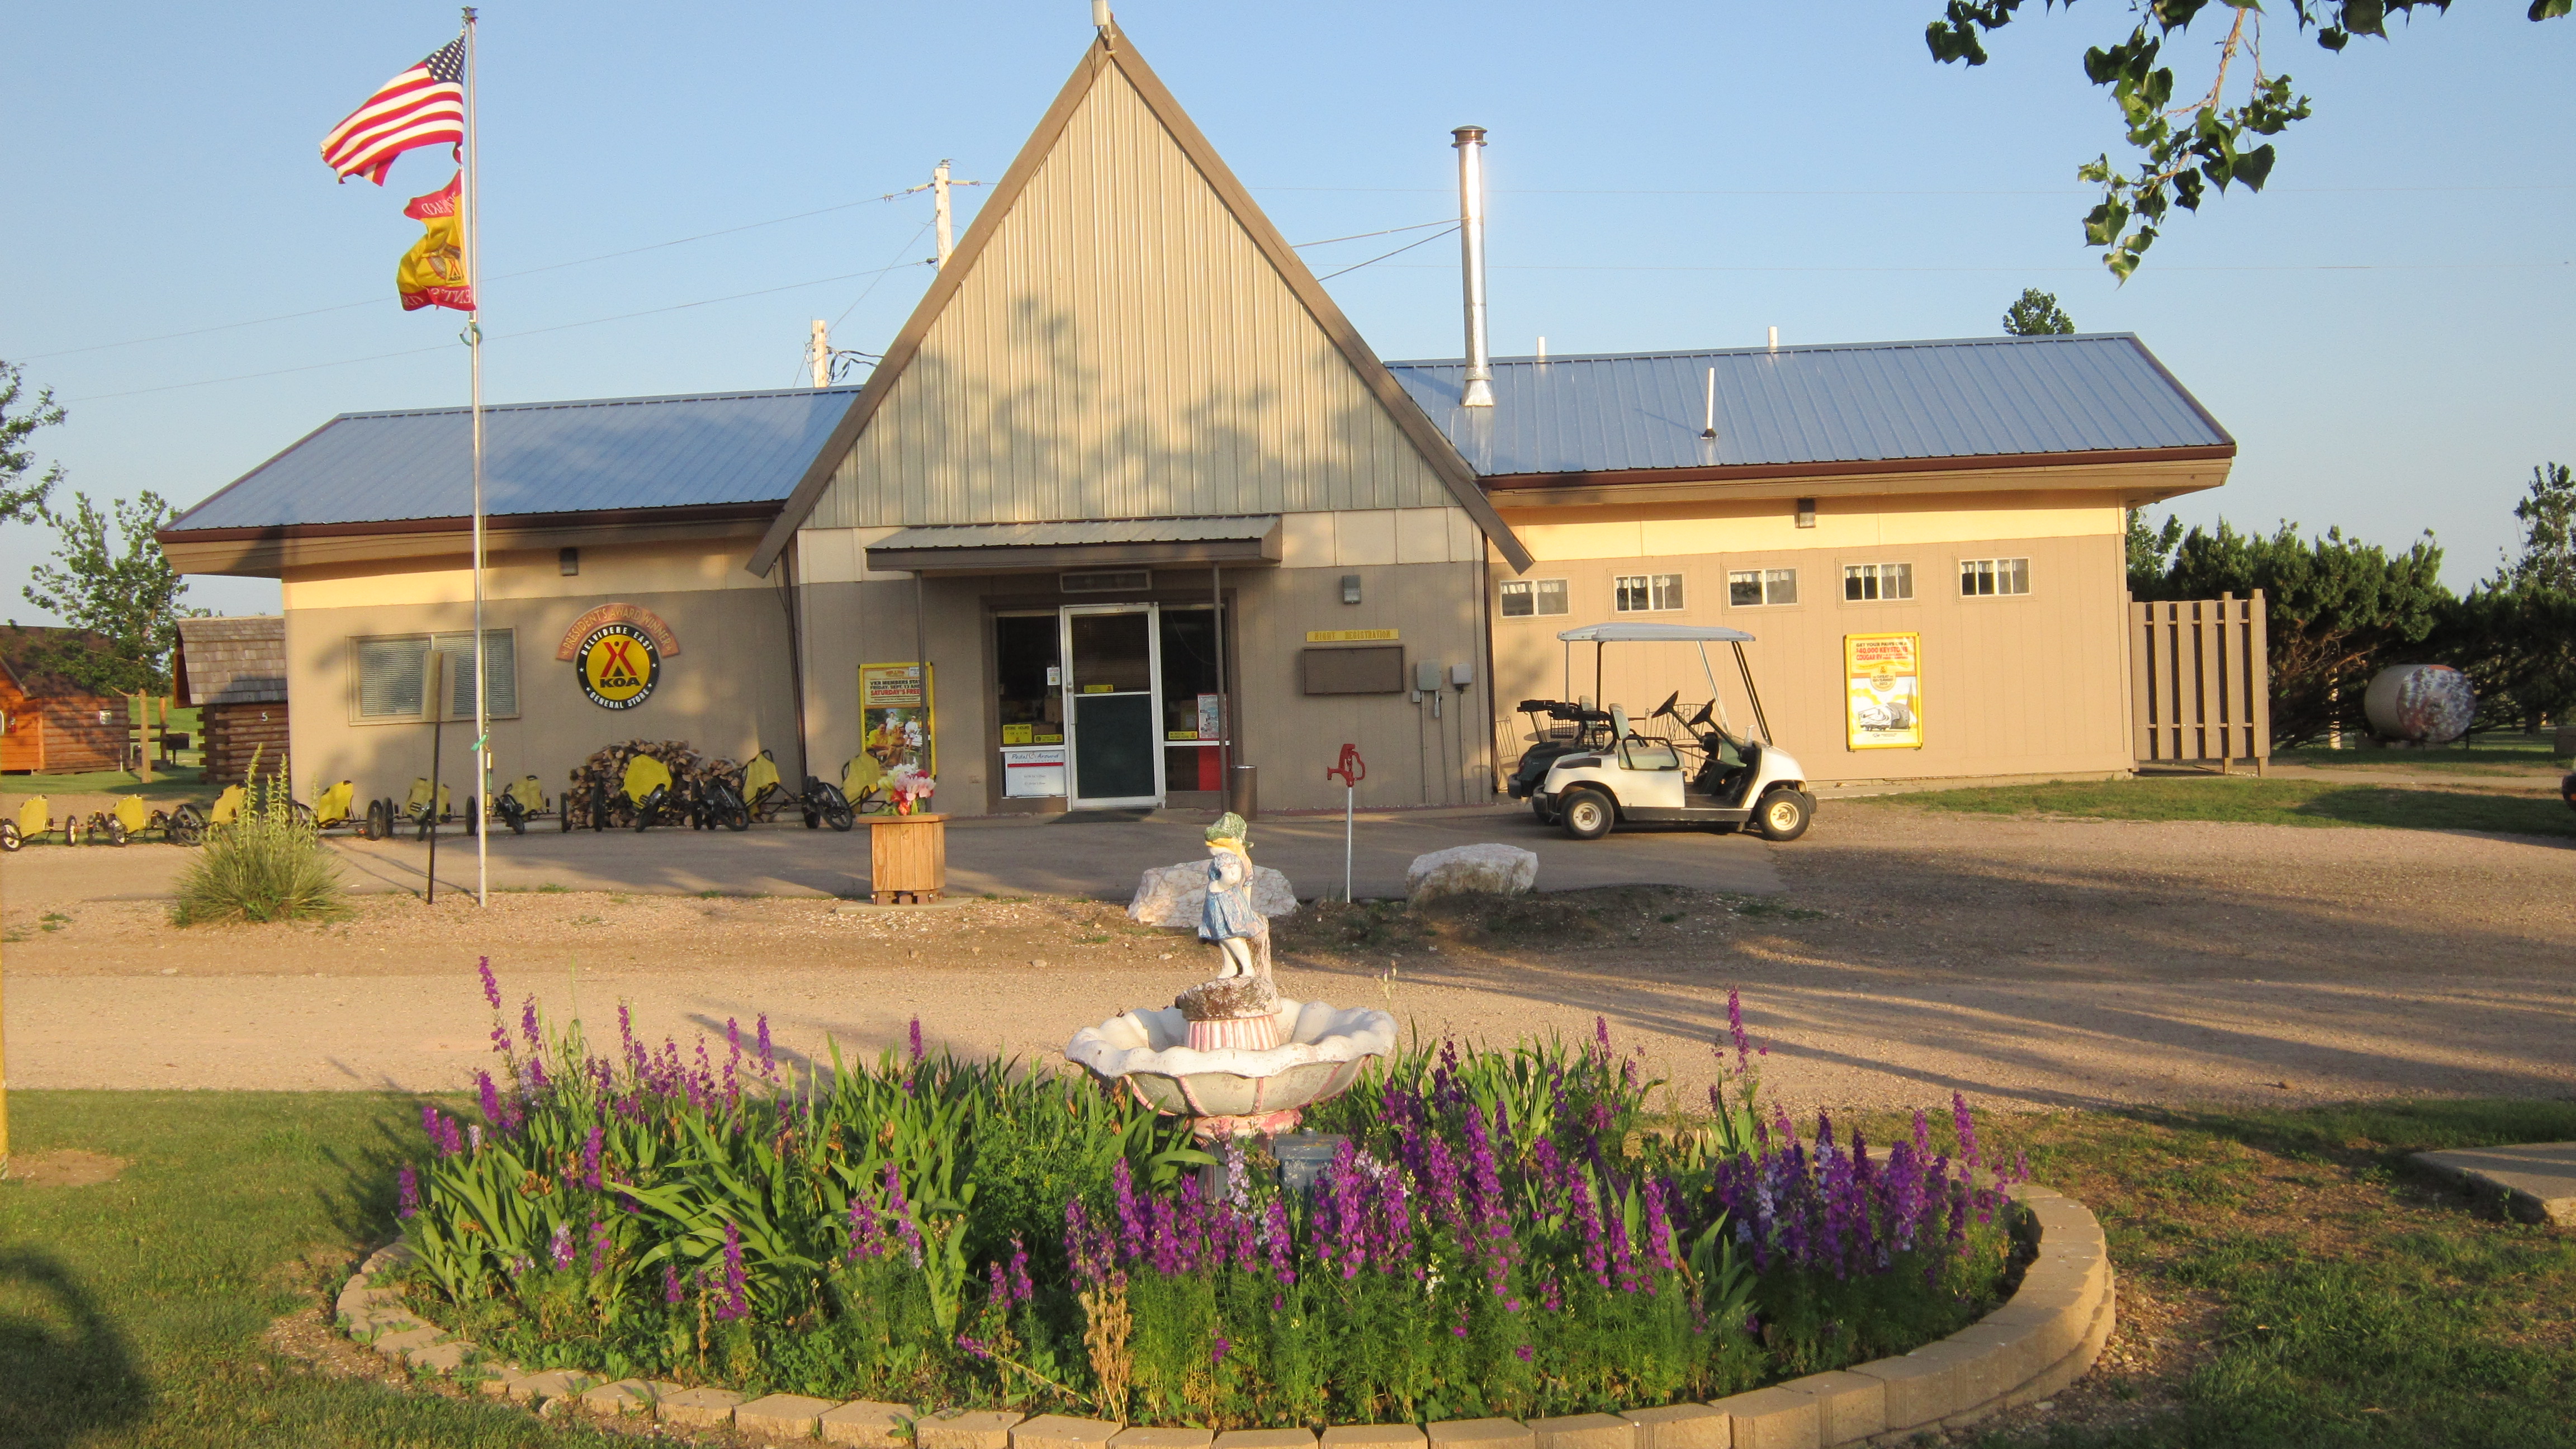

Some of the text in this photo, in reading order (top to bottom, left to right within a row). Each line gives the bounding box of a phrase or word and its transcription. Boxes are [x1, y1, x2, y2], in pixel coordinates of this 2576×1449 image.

[562, 608, 670, 650] PRESIDENT'S AWARD WINNER
[1314, 630, 1391, 641] NIGHT REGISTRATION
[581, 626, 654, 656] BELVIDERE EAST
[600, 677, 641, 688] KOA
[589, 689, 650, 709] GENERAL STORE
[261, 712, 268, 722] 5
